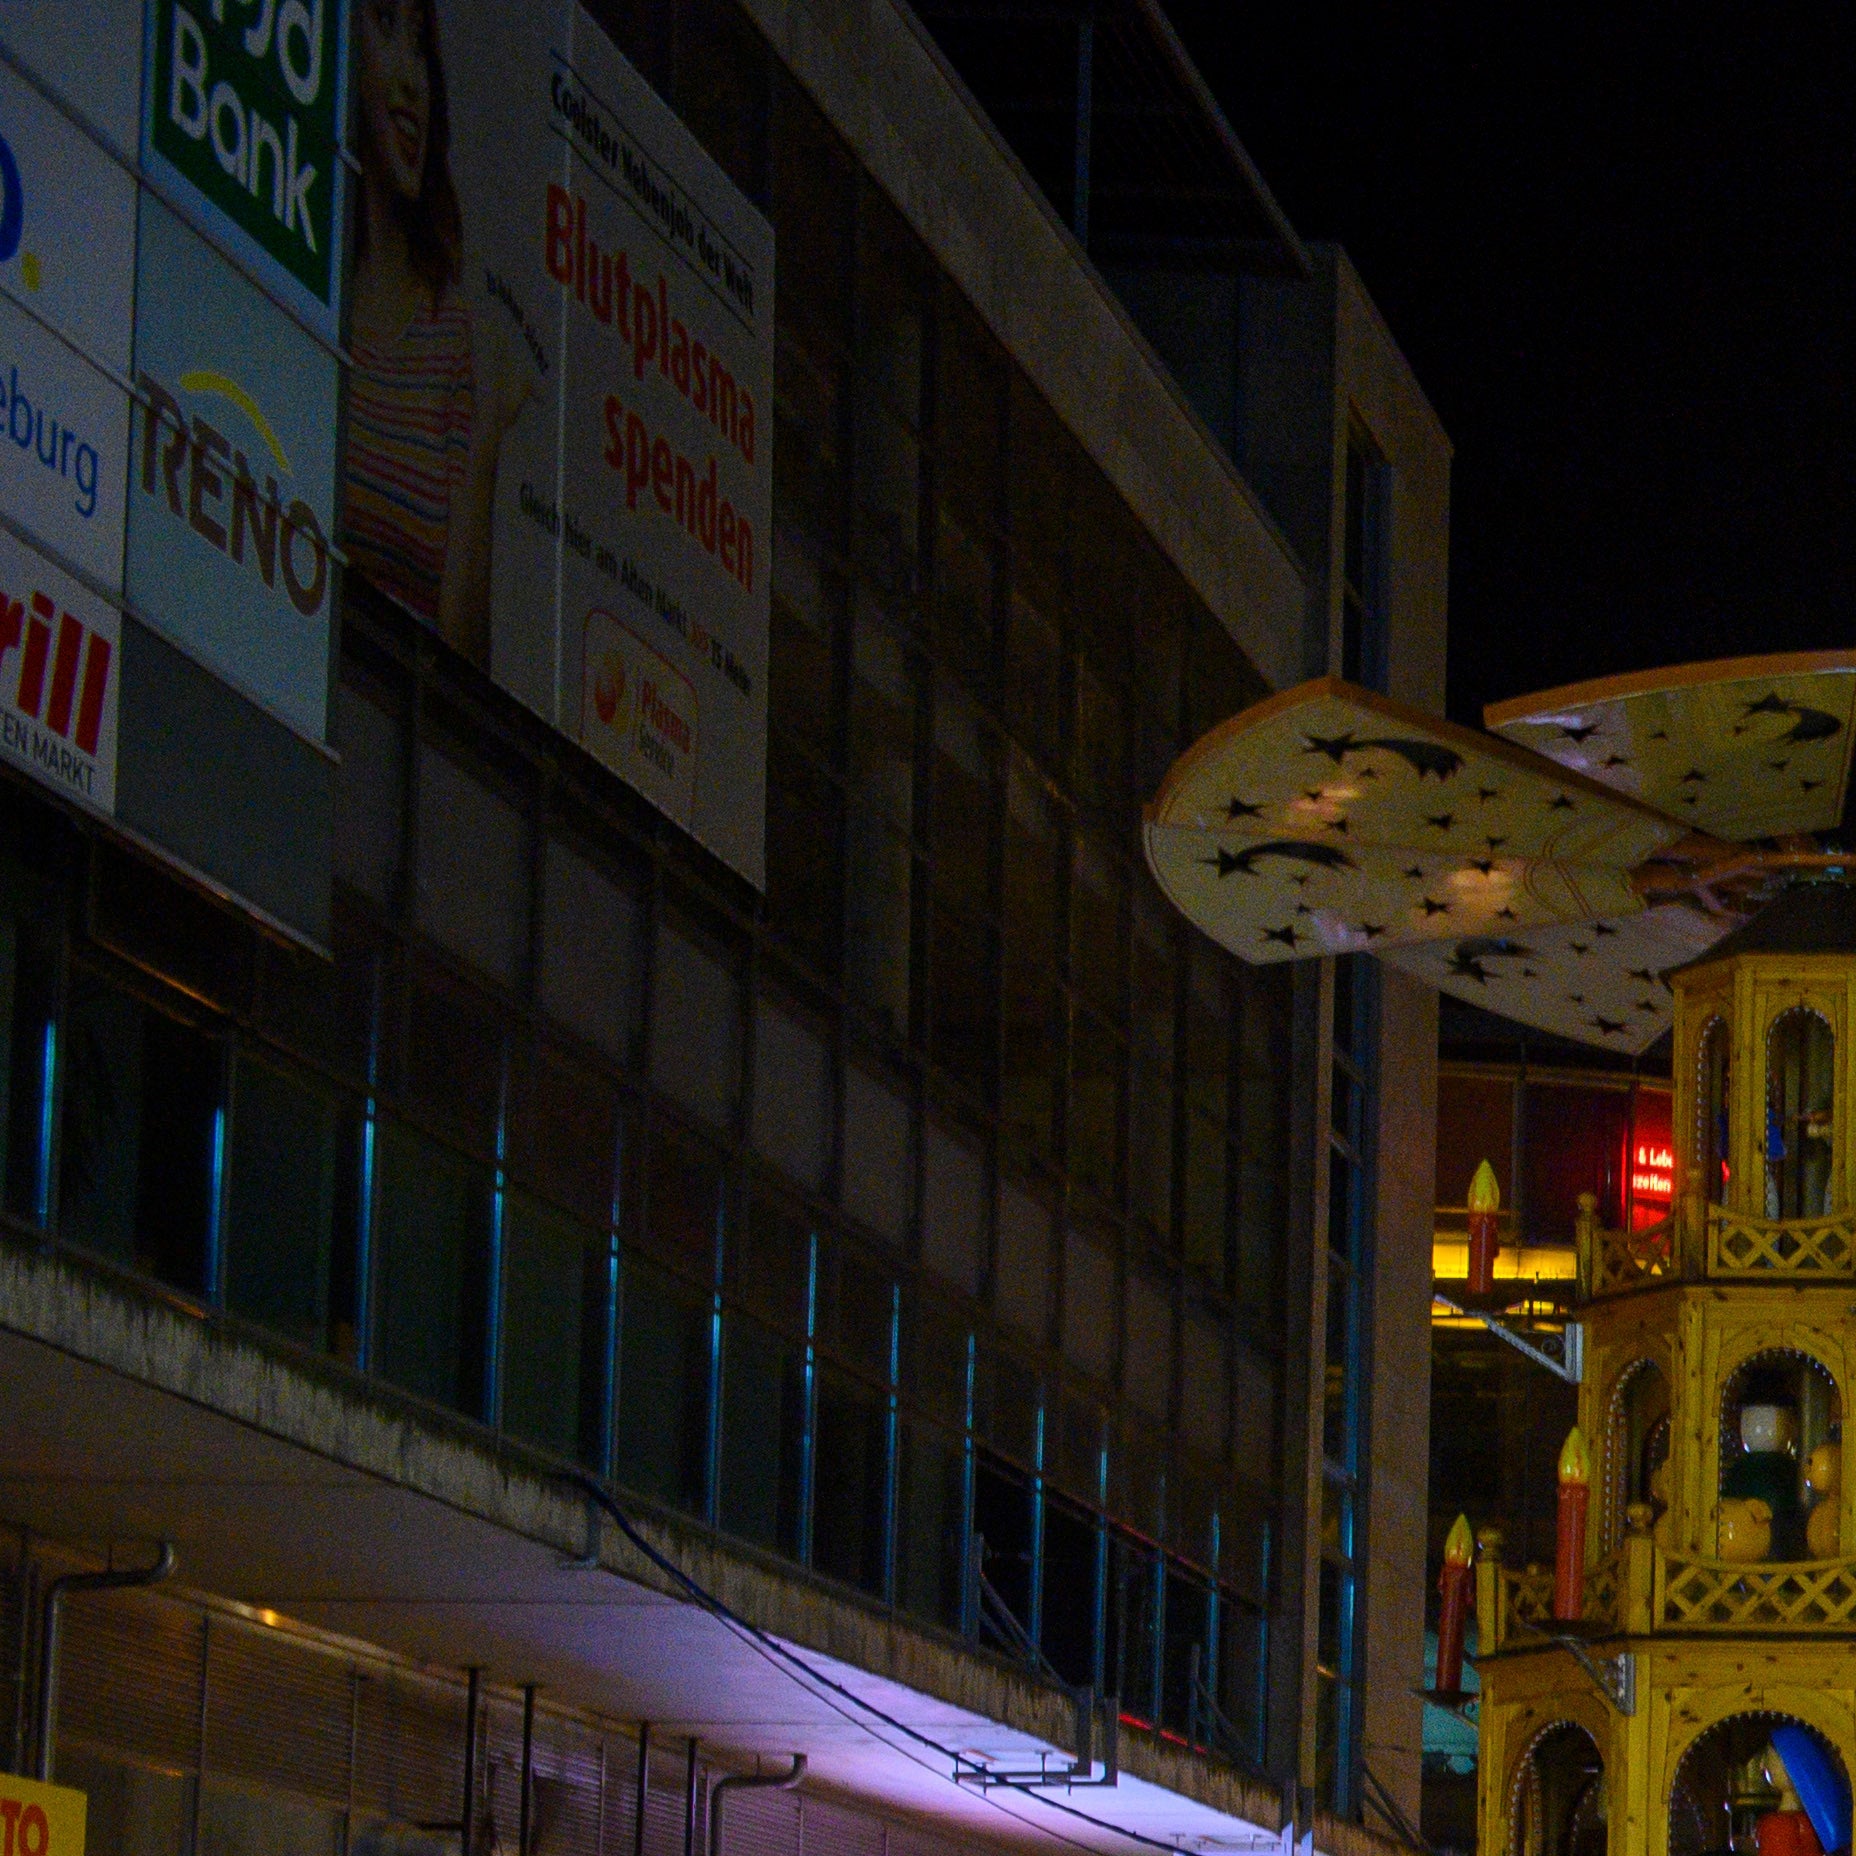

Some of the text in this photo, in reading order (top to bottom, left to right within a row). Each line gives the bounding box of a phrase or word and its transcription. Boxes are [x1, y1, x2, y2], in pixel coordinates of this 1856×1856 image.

[170, 2, 319, 255] Bank
[545, 182, 755, 466] Blutplasma
[135, 370, 327, 617] RENO
[603, 394, 754, 594] spenden
[0, 708, 95, 797] EN MARKT
